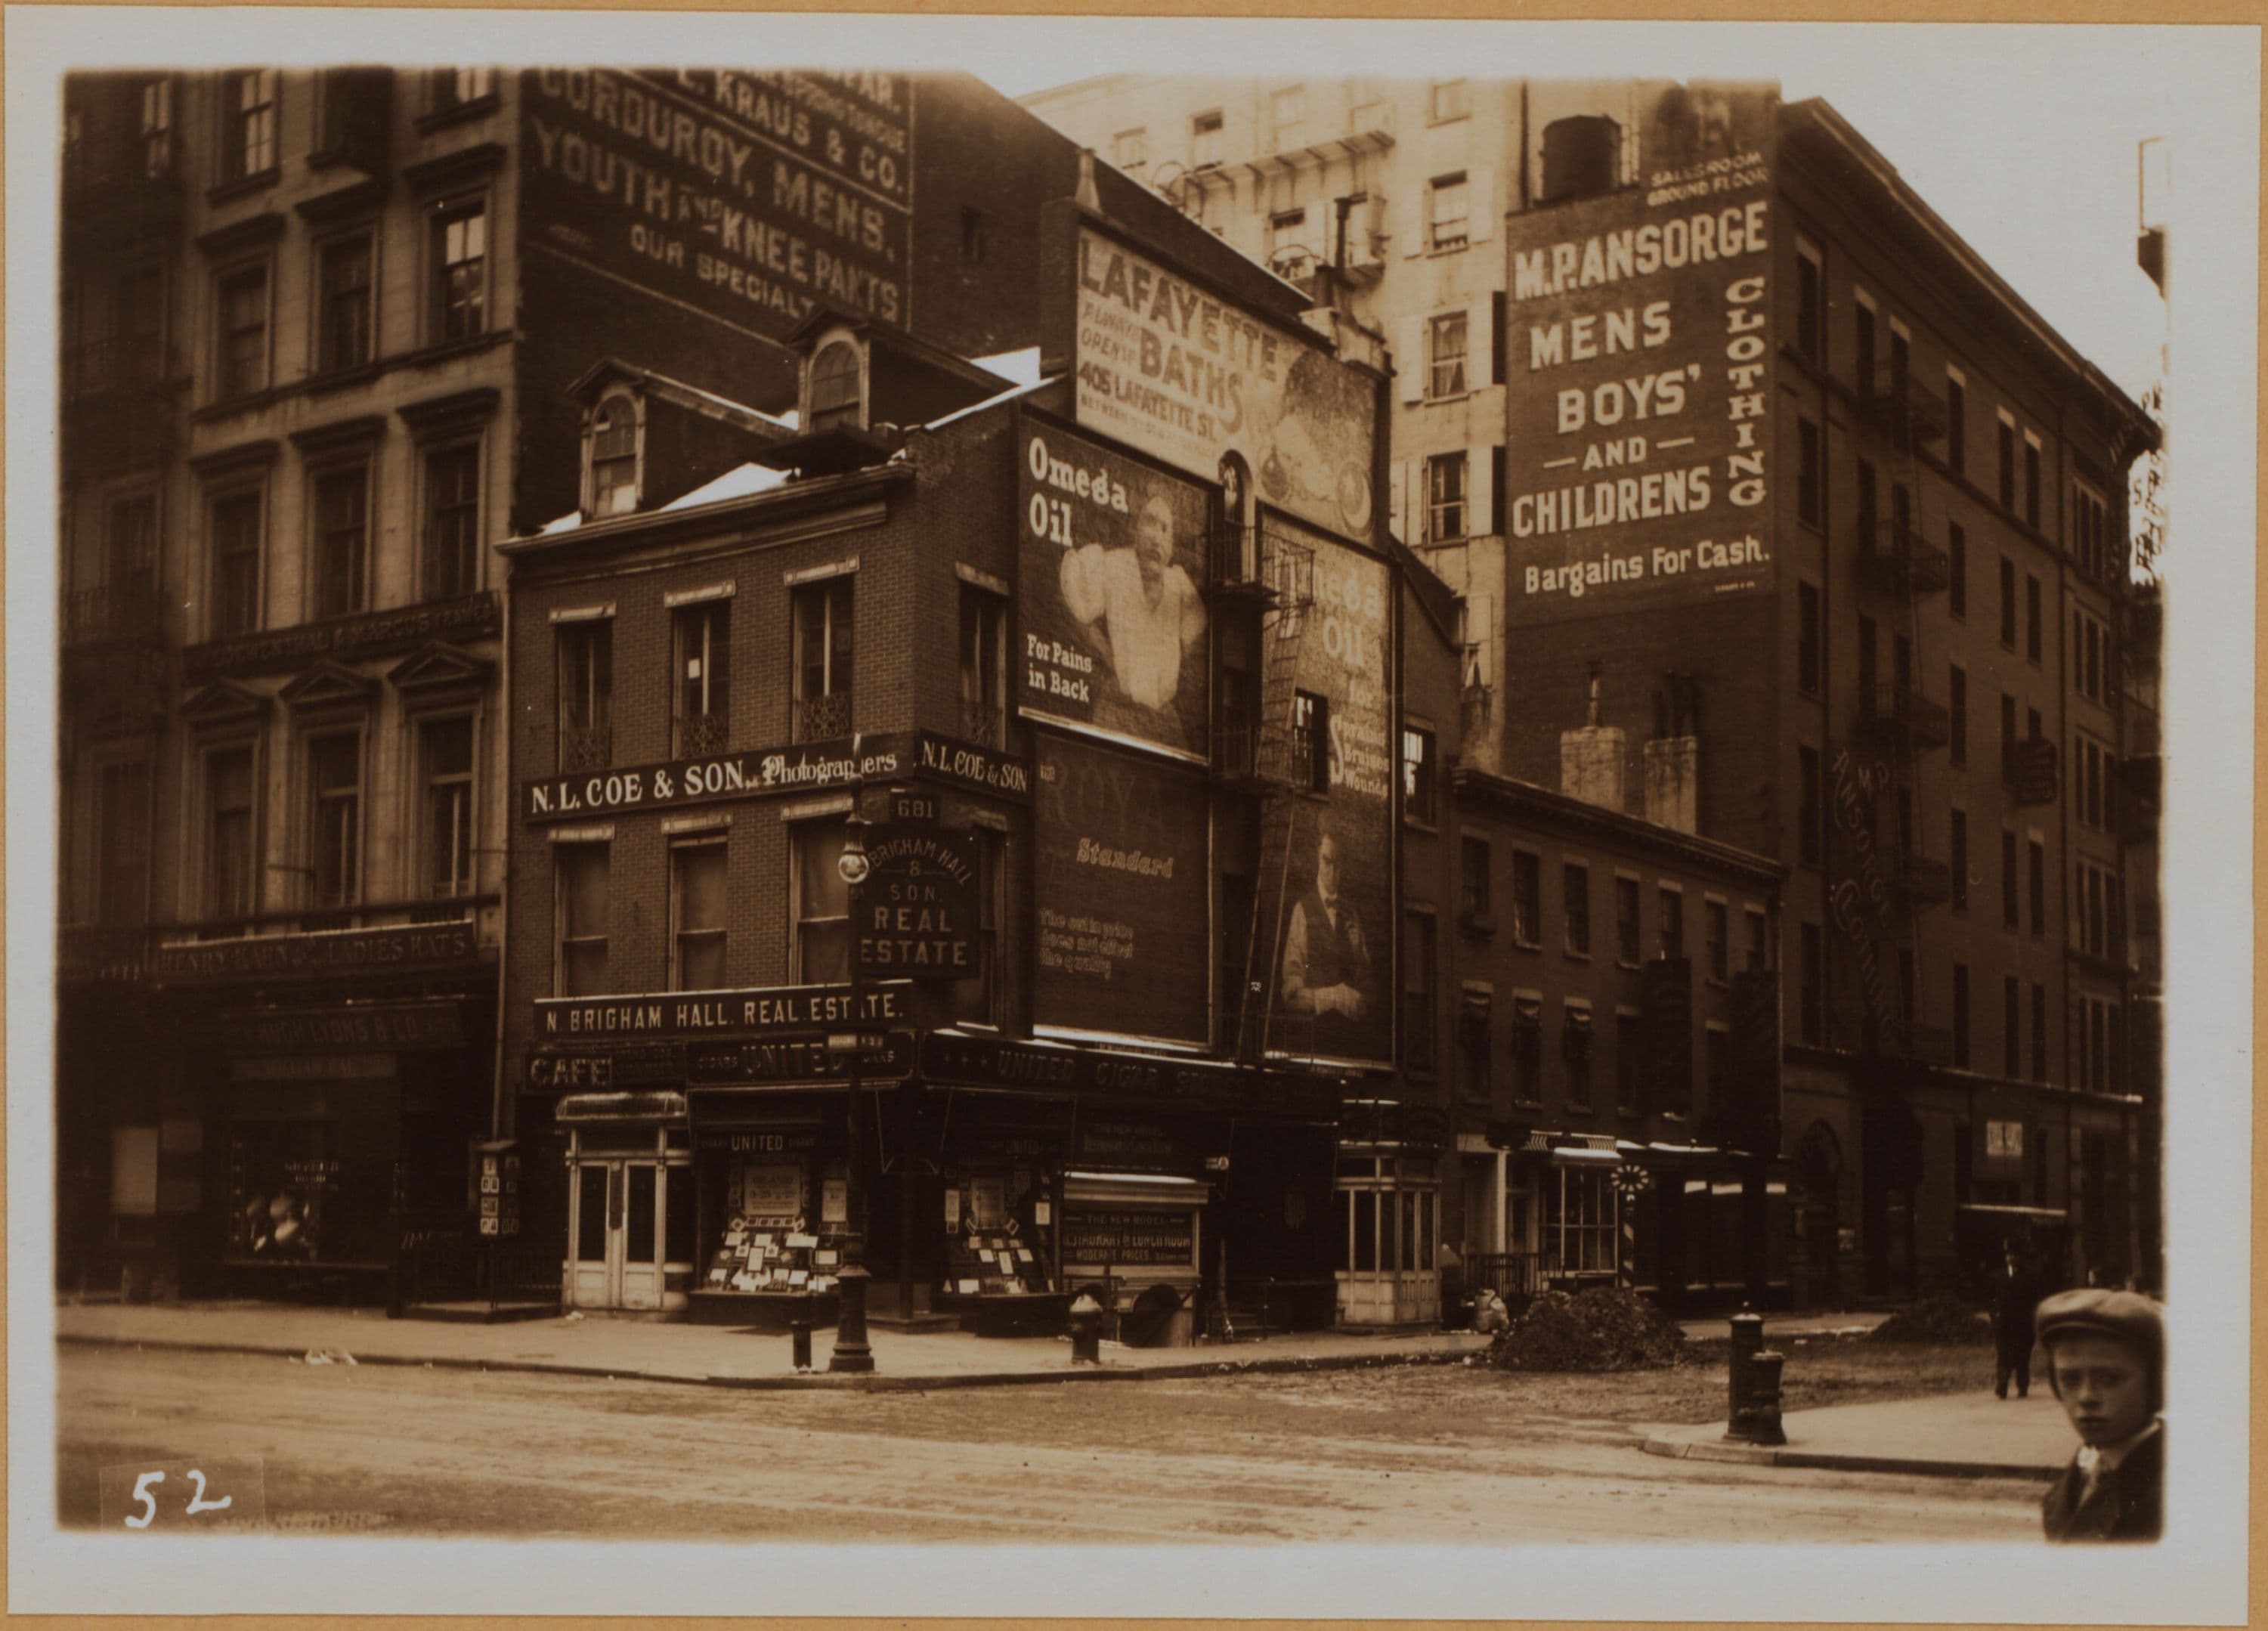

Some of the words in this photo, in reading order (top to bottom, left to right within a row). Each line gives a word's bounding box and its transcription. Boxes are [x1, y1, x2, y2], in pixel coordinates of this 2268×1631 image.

[714, 71, 811, 147] KRAUS
[827, 128, 846, 166] &
[859, 145, 904, 194] CO.
[531, 115, 671, 221] YOUTH
[722, 206, 809, 284] KNEE
[815, 248, 899, 323] PANTS
[630, 224, 683, 268] OUR
[1081, 239, 1277, 383] LAFAYETTE
[1530, 300, 1671, 370] MENS
[1139, 327, 1243, 435] BATHS
[1558, 363, 1702, 435] BOYS'
[1725, 277, 1767, 508] CLOTHING
[1029, 436, 1128, 514] Omega
[1583, 435, 1648, 470] AND
[1029, 491, 1072, 546] Oil
[1513, 466, 1712, 538] CHILDRENS
[1525, 552, 1645, 599] Bargains
[1652, 546, 1691, 576] For
[1697, 534, 1770, 570] Cash.
[1027, 633, 1050, 661] For
[1051, 641, 1092, 673] Pains
[1323, 616, 1365, 670] Oil
[1028, 662, 1046, 692] in
[1049, 670, 1090, 704] Back
[531, 769, 555, 814] N.
[558, 766, 581, 811] L.
[585, 773, 643, 808] COE
[653, 768, 674, 800] &
[955, 750, 985, 781] COE
[986, 763, 998, 787] &
[999, 763, 1027, 793] SON
[898, 799, 934, 819] 681
[1076, 835, 1175, 880] Standard
[874, 906, 953, 933] REAL
[861, 939, 968, 966] ESTATE
[570, 1004, 663, 1032] BRIGHAM
[530, 1057, 613, 1088] CAFE
[731, 1134, 784, 1152] UNITED
